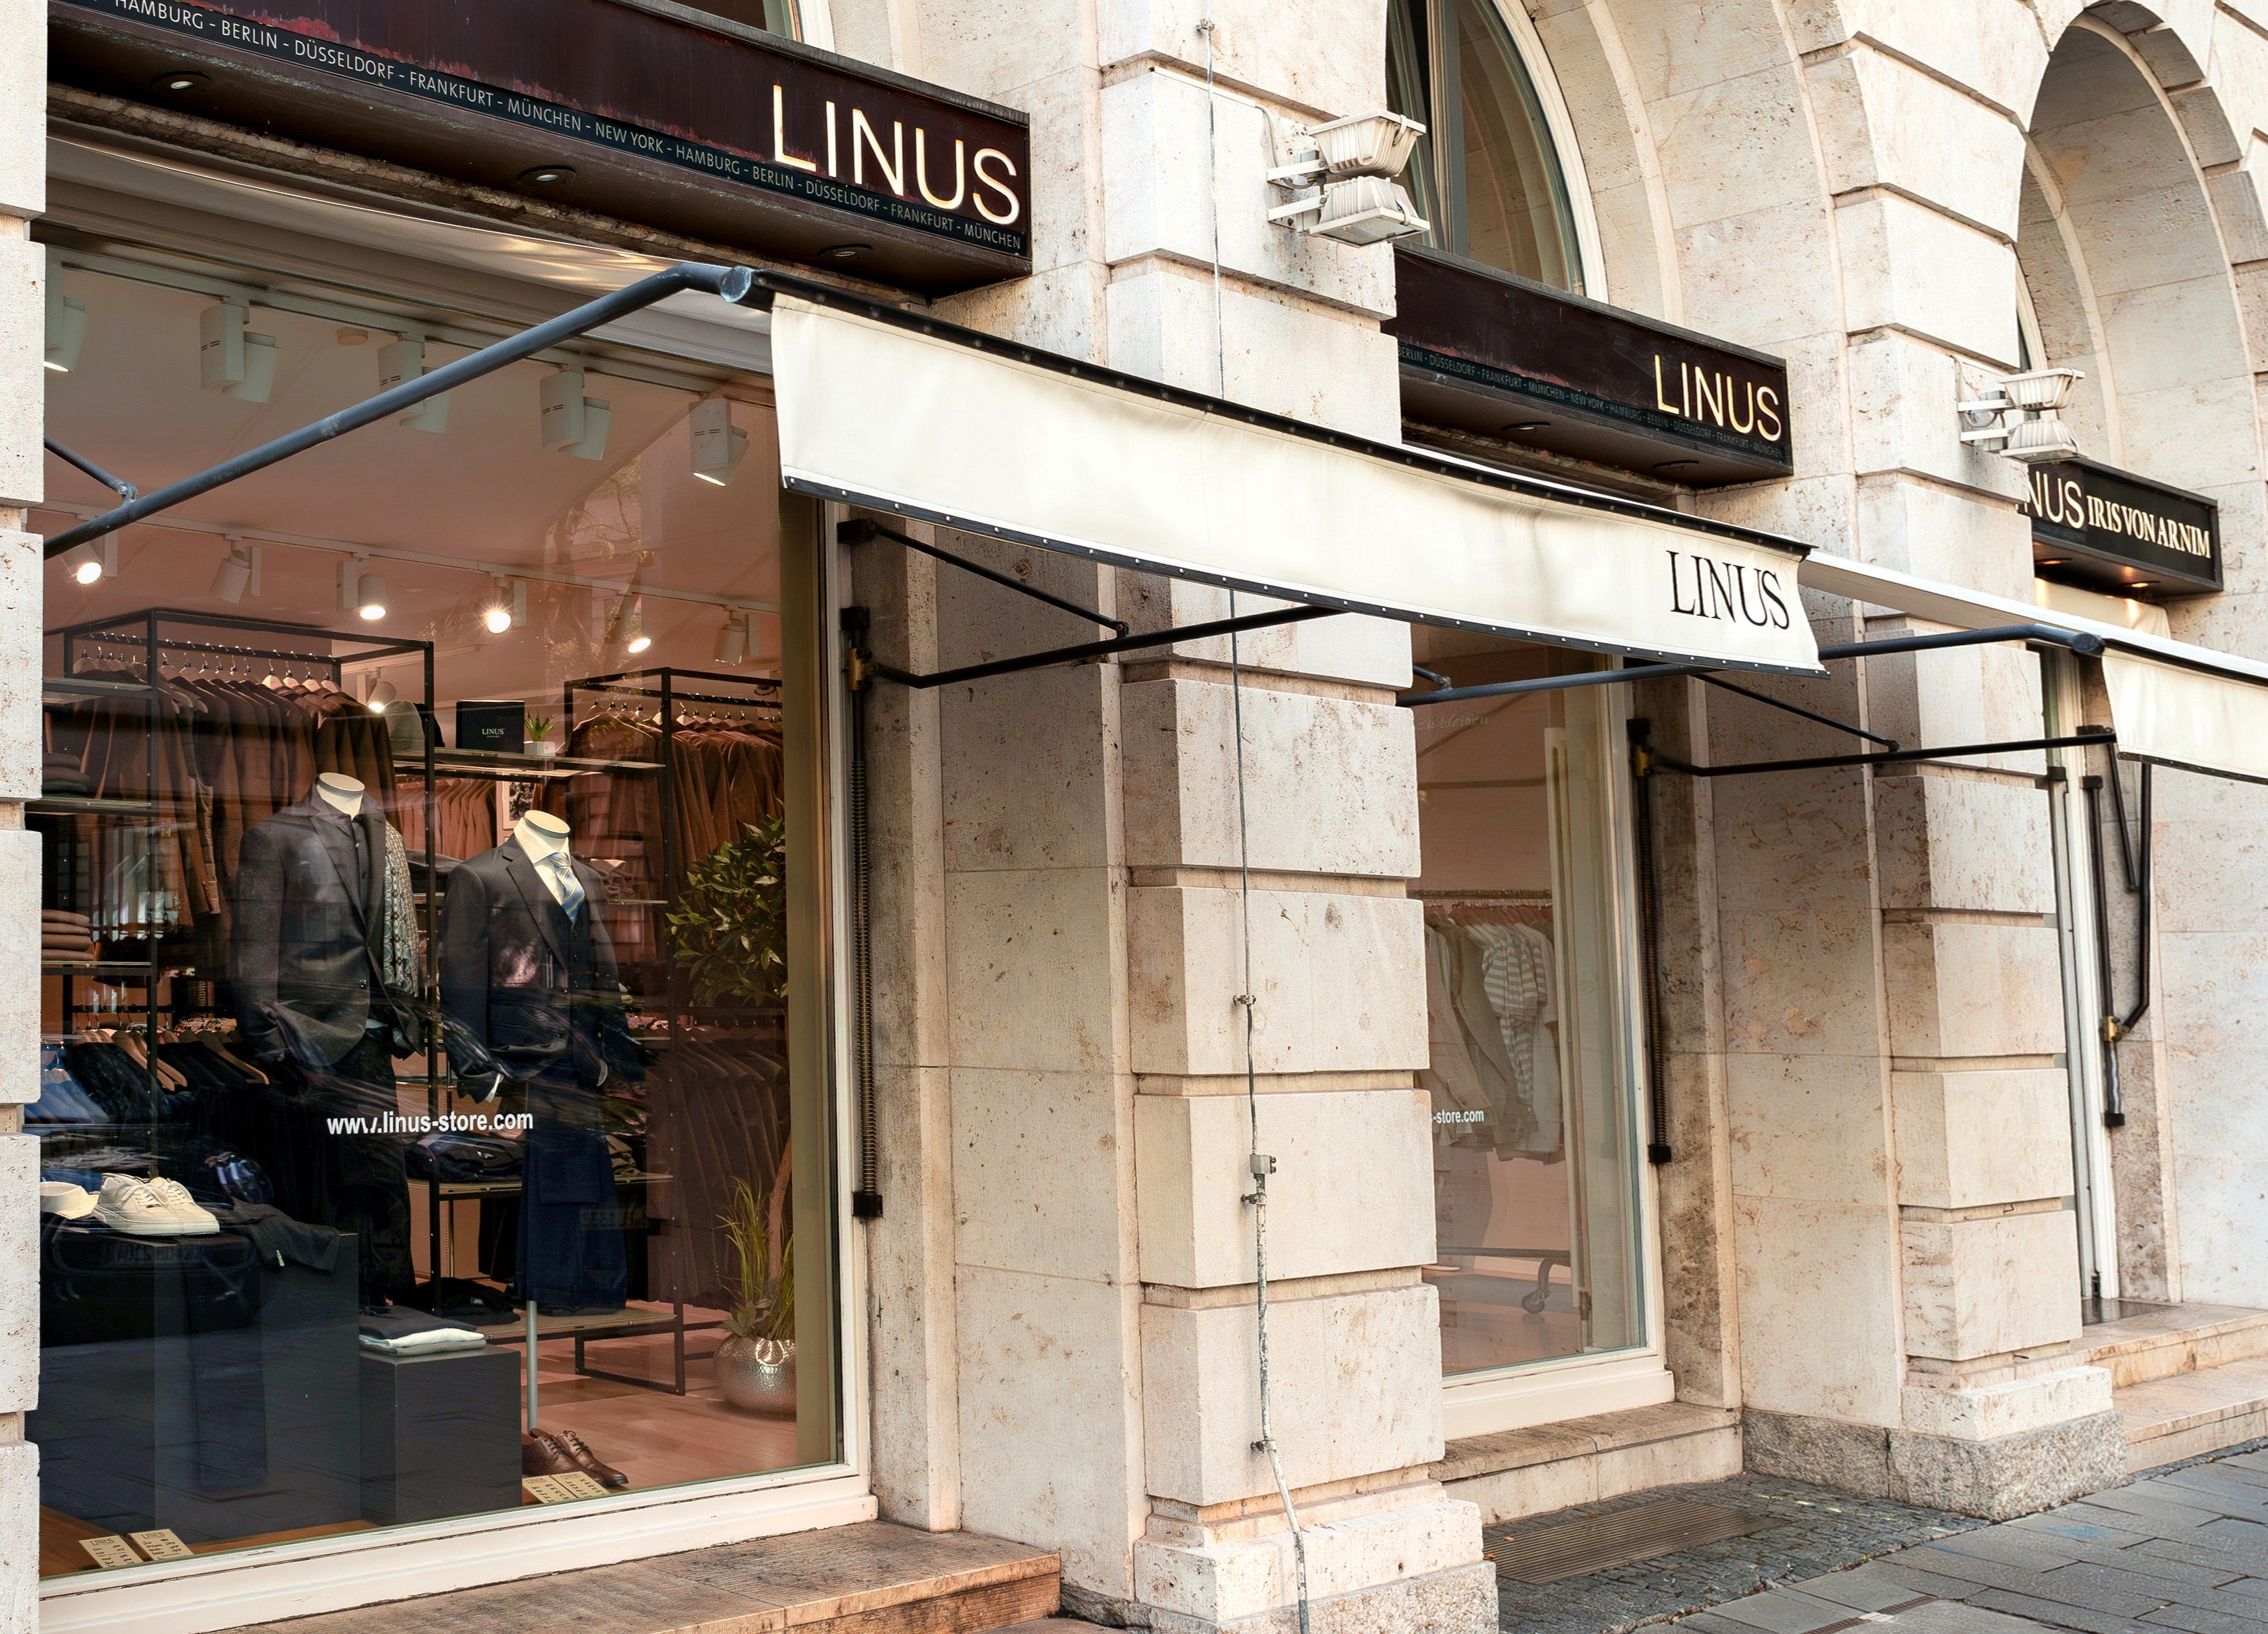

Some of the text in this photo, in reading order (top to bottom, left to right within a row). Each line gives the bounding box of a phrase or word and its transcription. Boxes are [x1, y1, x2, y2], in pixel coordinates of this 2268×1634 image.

[222, 20, 277, 49] BERLIN
[295, 39, 394, 79] DÜSSELDORF
[410, 71, 494, 107] FRANKFURT
[508, 98, 581, 131] MÜNCHEN
[596, 122, 627, 143] NEW
[630, 131, 664, 154] YORK
[676, 144, 740, 175] HAMBURG
[753, 166, 794, 189] BERLIN
[806, 179, 881, 212] DÜSSELDORF
[890, 204, 954, 232] FRANKFURT
[964, 222, 1021, 250] MÜNCHEN
[773, 84, 1020, 225] LINUS
[1430, 353, 1476, 376] DÜSSELDORF
[1481, 369, 1522, 388] FRANKFURT
[1570, 393, 1587, 406] NEW
[1654, 354, 1782, 442] LINUS
[2015, 471, 2211, 559] NUS IRIS VON ARNIM
[1665, 550, 1789, 630] LINUS
[327, 1111, 533, 1135] www.linus-store.com
